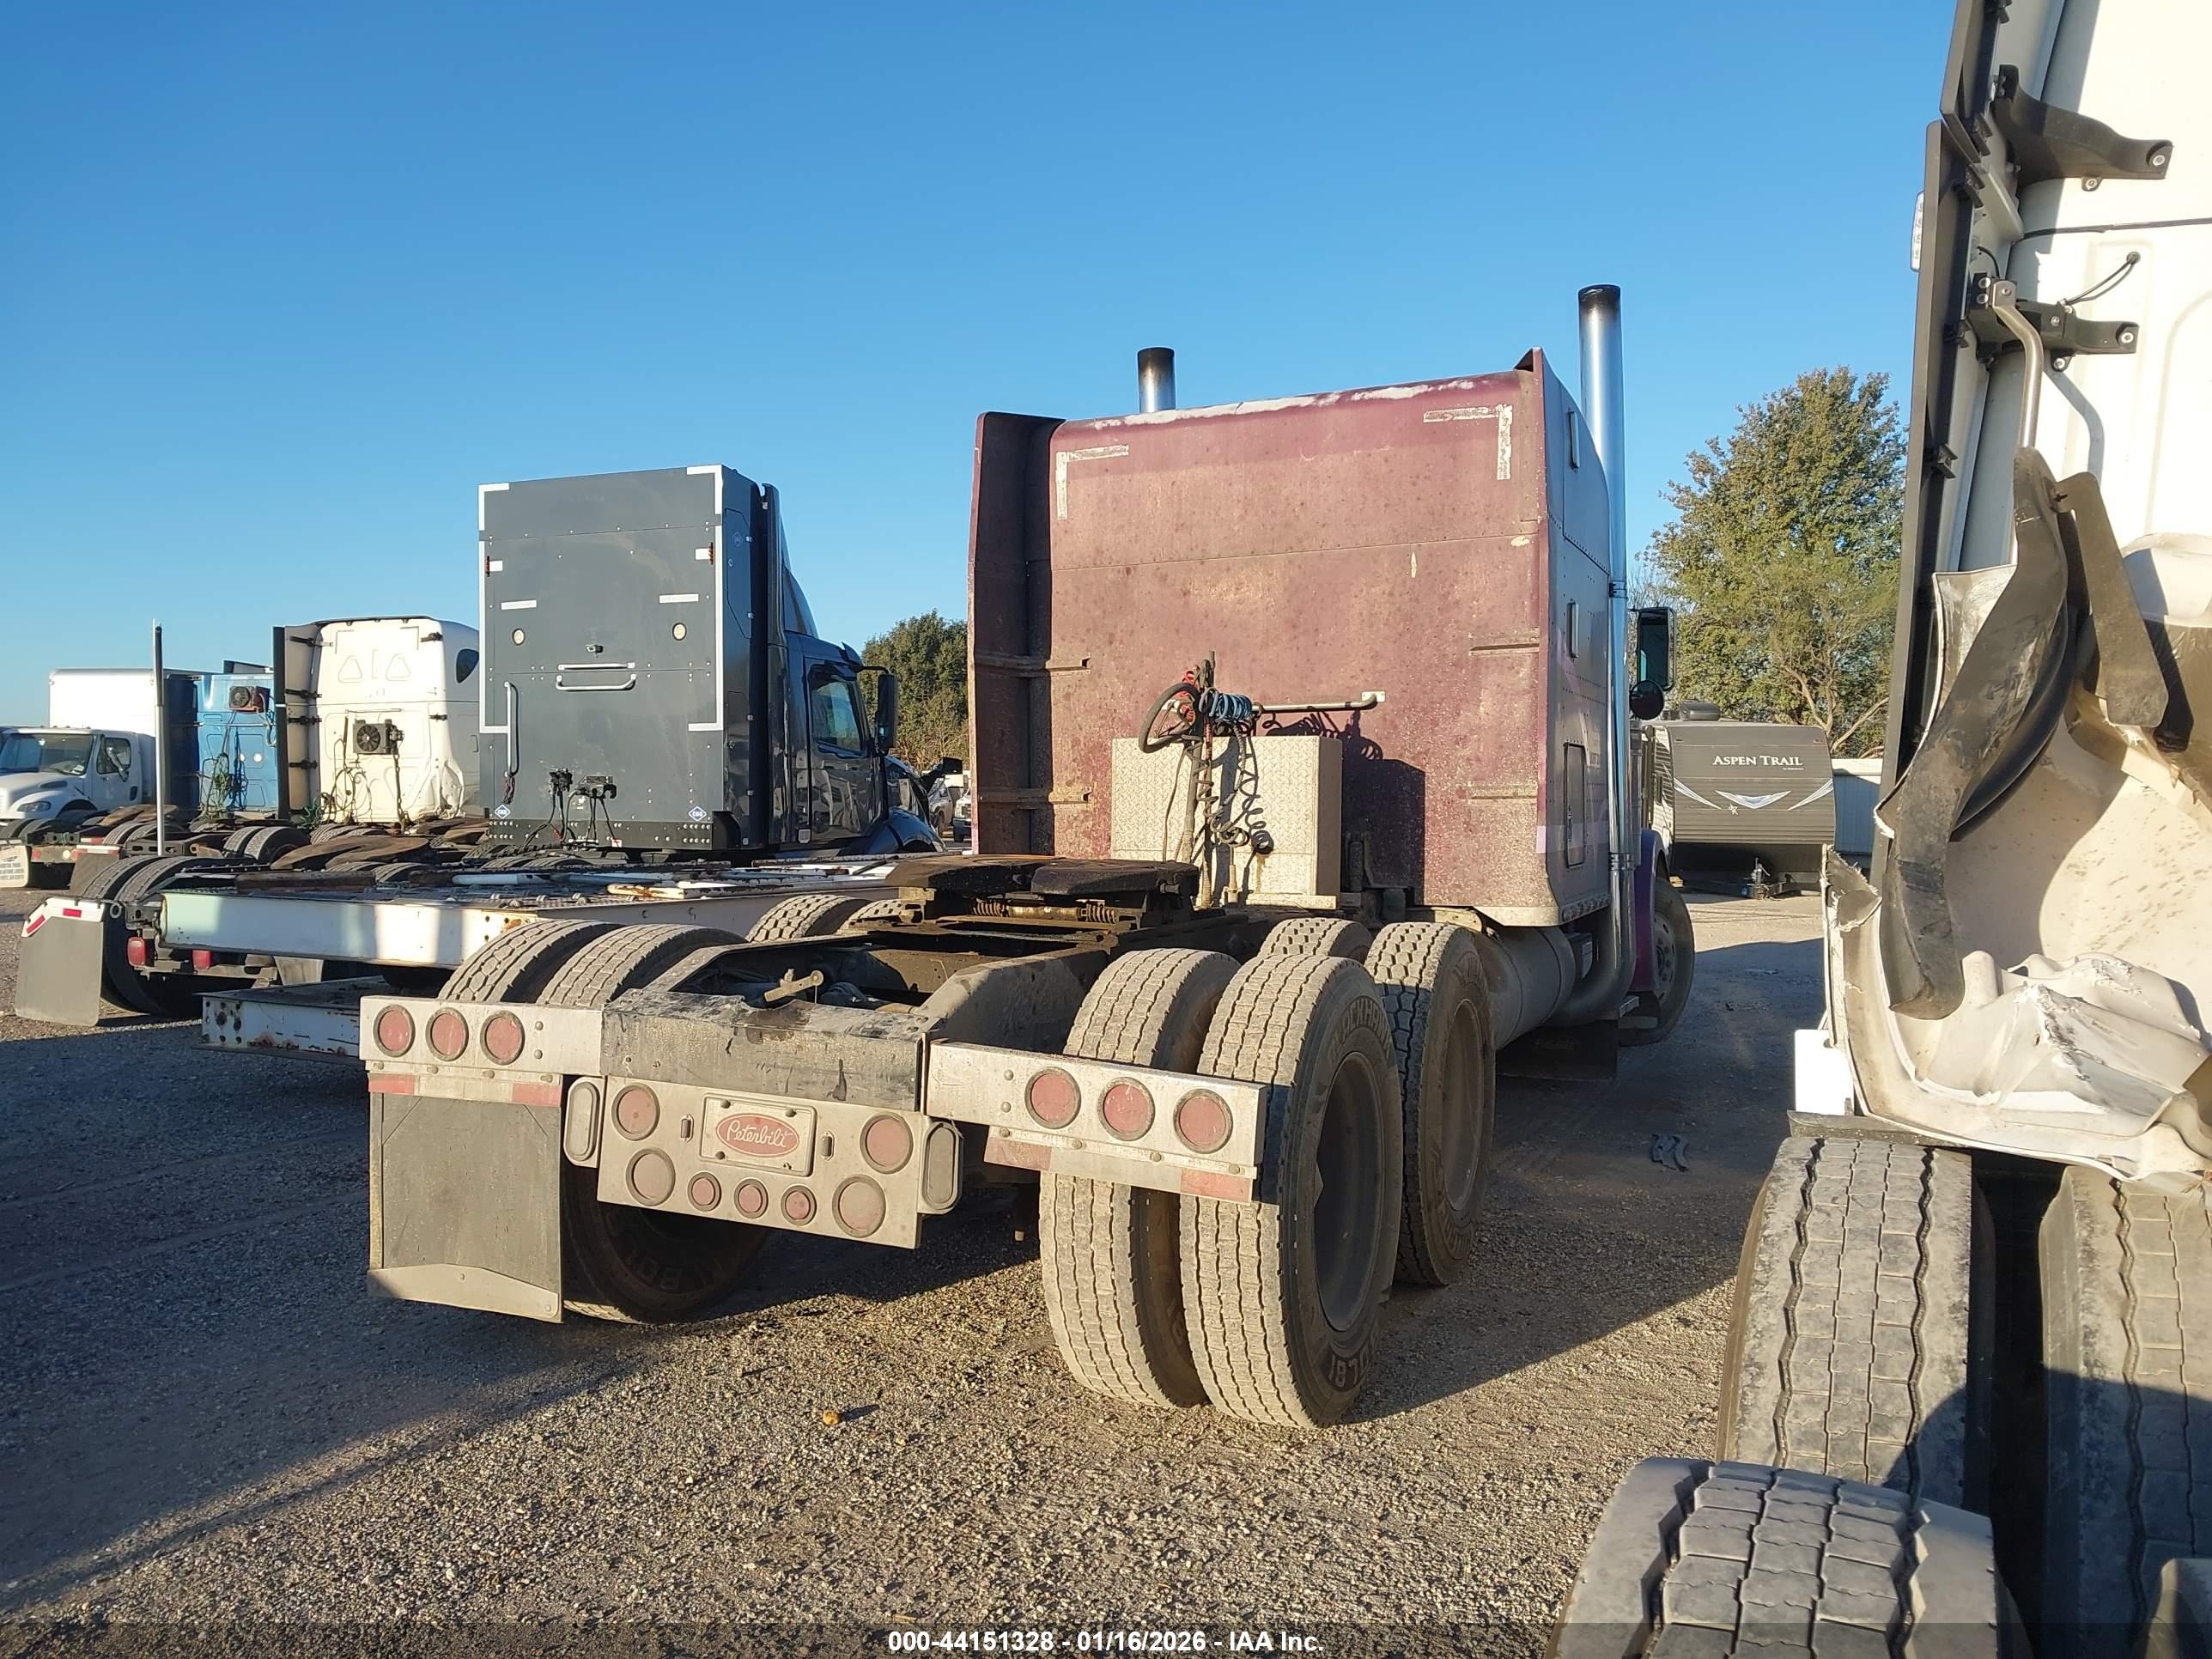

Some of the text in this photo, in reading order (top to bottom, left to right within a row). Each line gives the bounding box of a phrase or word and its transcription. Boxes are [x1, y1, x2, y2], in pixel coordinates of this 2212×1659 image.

[1712, 756, 1803, 766] ASPEN TRAIL
[726, 1120, 793, 1148] Peterbilt
